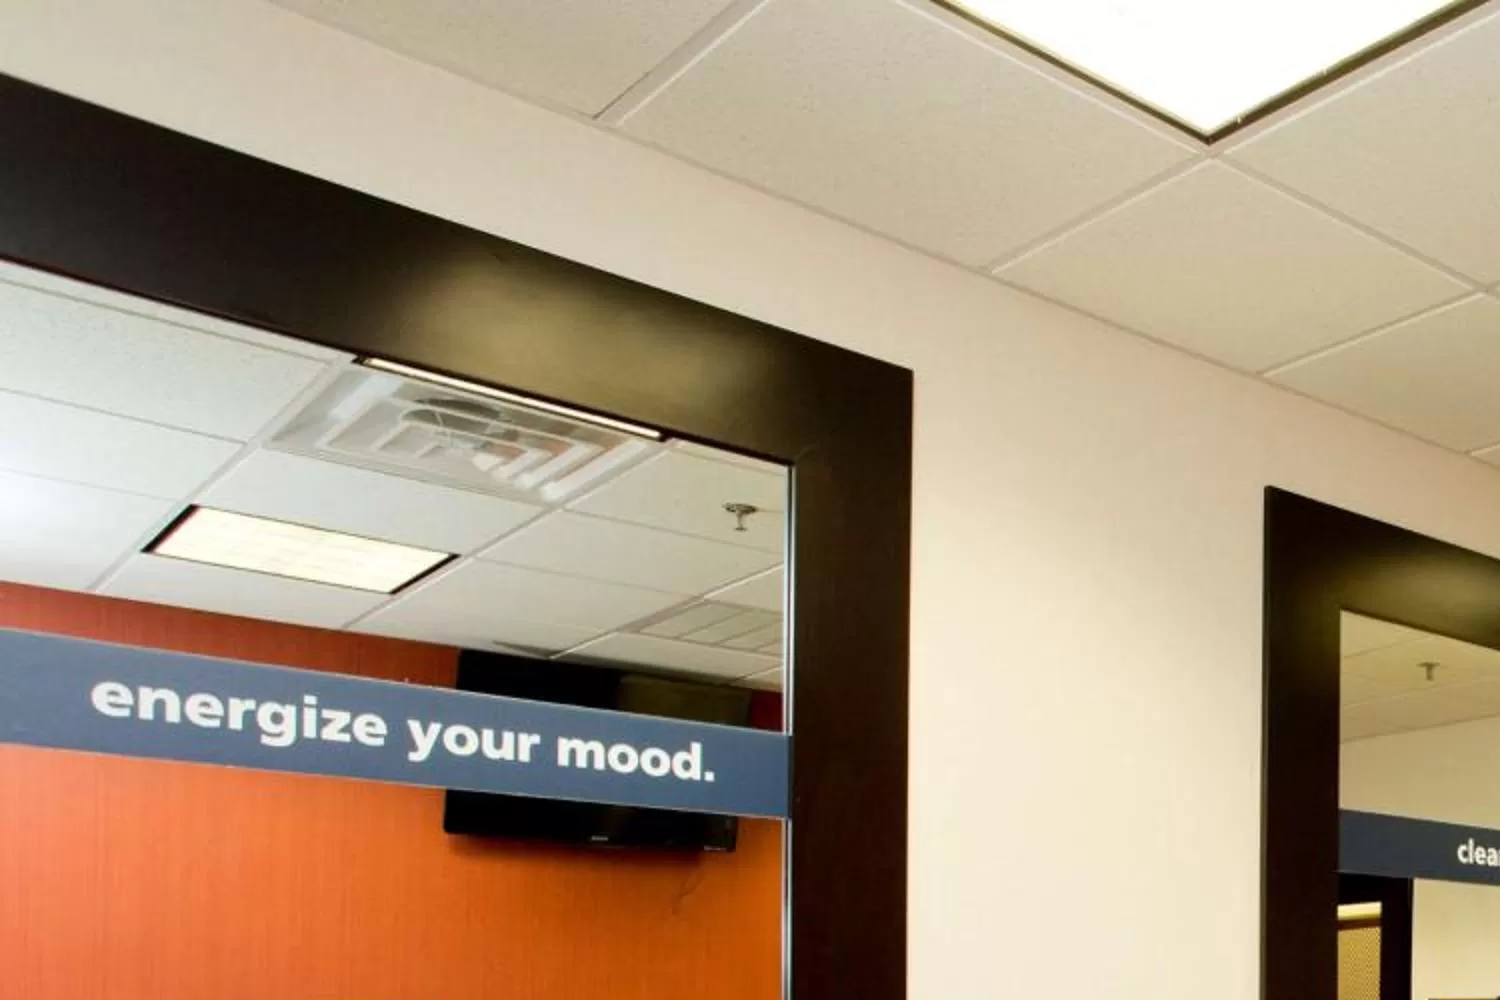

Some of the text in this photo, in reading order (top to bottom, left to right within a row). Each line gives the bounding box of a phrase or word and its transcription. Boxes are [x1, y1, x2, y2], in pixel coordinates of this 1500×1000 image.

[91, 681, 715, 782] energize your mood.
